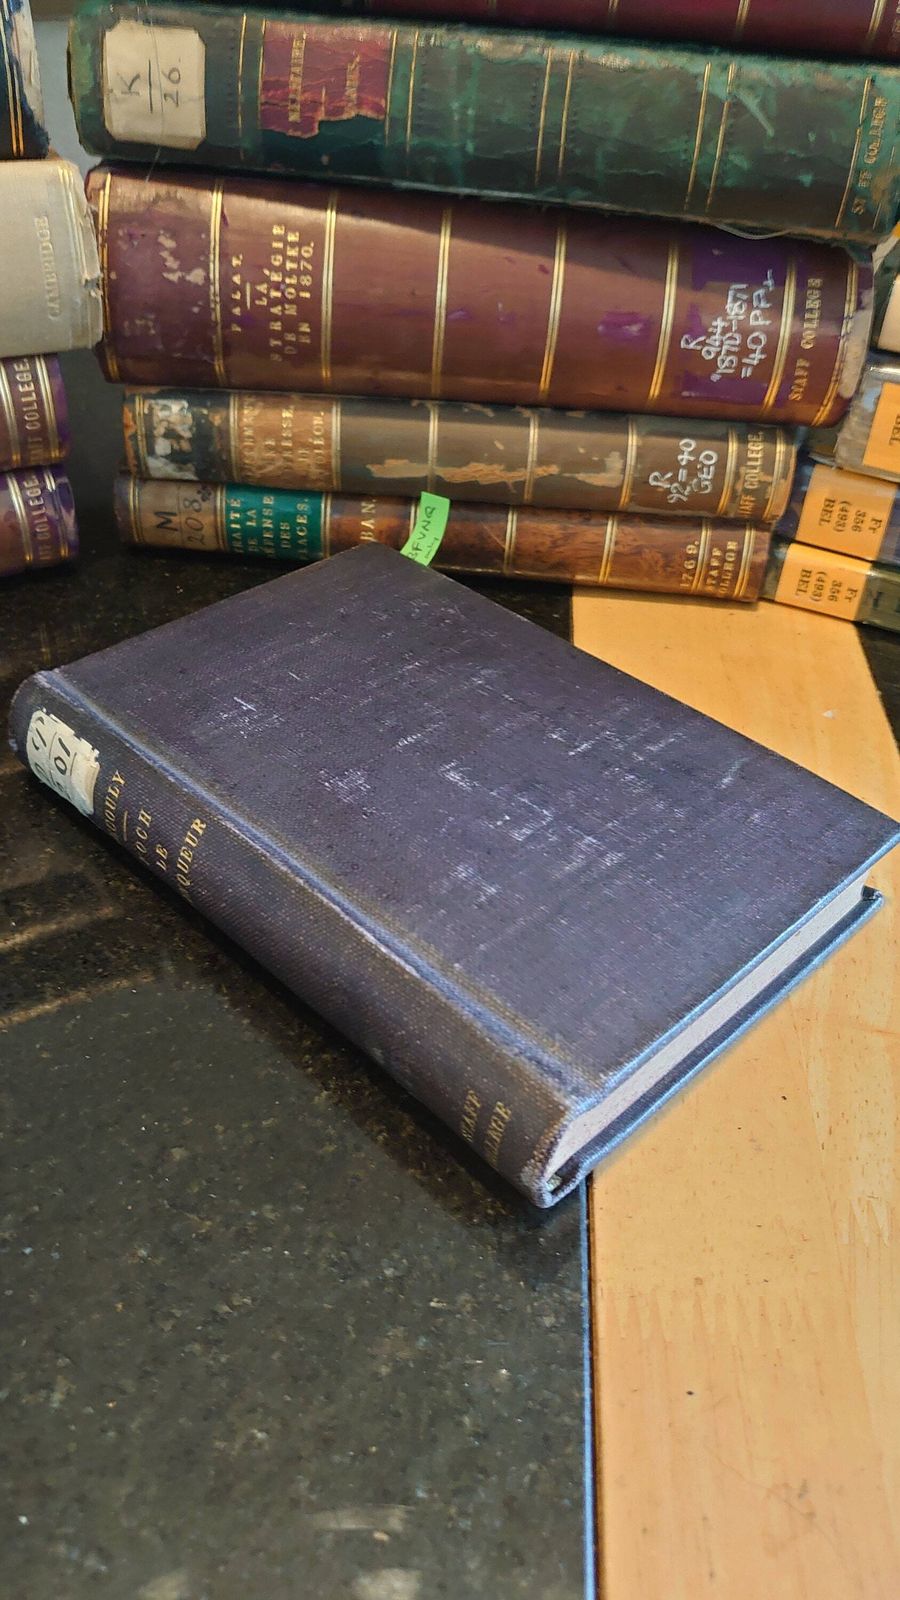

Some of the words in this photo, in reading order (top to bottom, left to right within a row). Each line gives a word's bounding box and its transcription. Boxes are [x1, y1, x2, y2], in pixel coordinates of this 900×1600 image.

[117, 73, 141, 96] K
[34, 216, 61, 321] CAMBRIDGE
[284, 231, 300, 315] MOLTKE
[299, 241, 314, 299] 1870.
[255, 282, 268, 306] LA
[284, 332, 297, 354] DE
[298, 322, 311, 344] EN
[680, 334, 706, 349] R
[702, 316, 729, 360] 944
[13, 357, 41, 431] COLLEGE.
[744, 432, 765, 490] COLLEGE.
[649, 471, 673, 488] R
[154, 510, 179, 532] M
[246, 509, 257, 527] LA
[359, 499, 376, 542] BAN.
[819, 498, 836, 526] BEL
[833, 501, 852, 532] (493)
[851, 510, 866, 533] 356
[868, 517, 883, 534] Fr
[280, 521, 291, 548] DES
[680, 540, 699, 588] 1769.
[719, 541, 738, 594] OLLEGE
[796, 568, 813, 596] BEL
[809, 571, 827, 602] (493)
[828, 580, 842, 602] 356
[844, 587, 858, 603] Fr
[105, 769, 125, 836] COULY
[156, 844, 169, 871] LE
[176, 818, 207, 893] QUEUR
